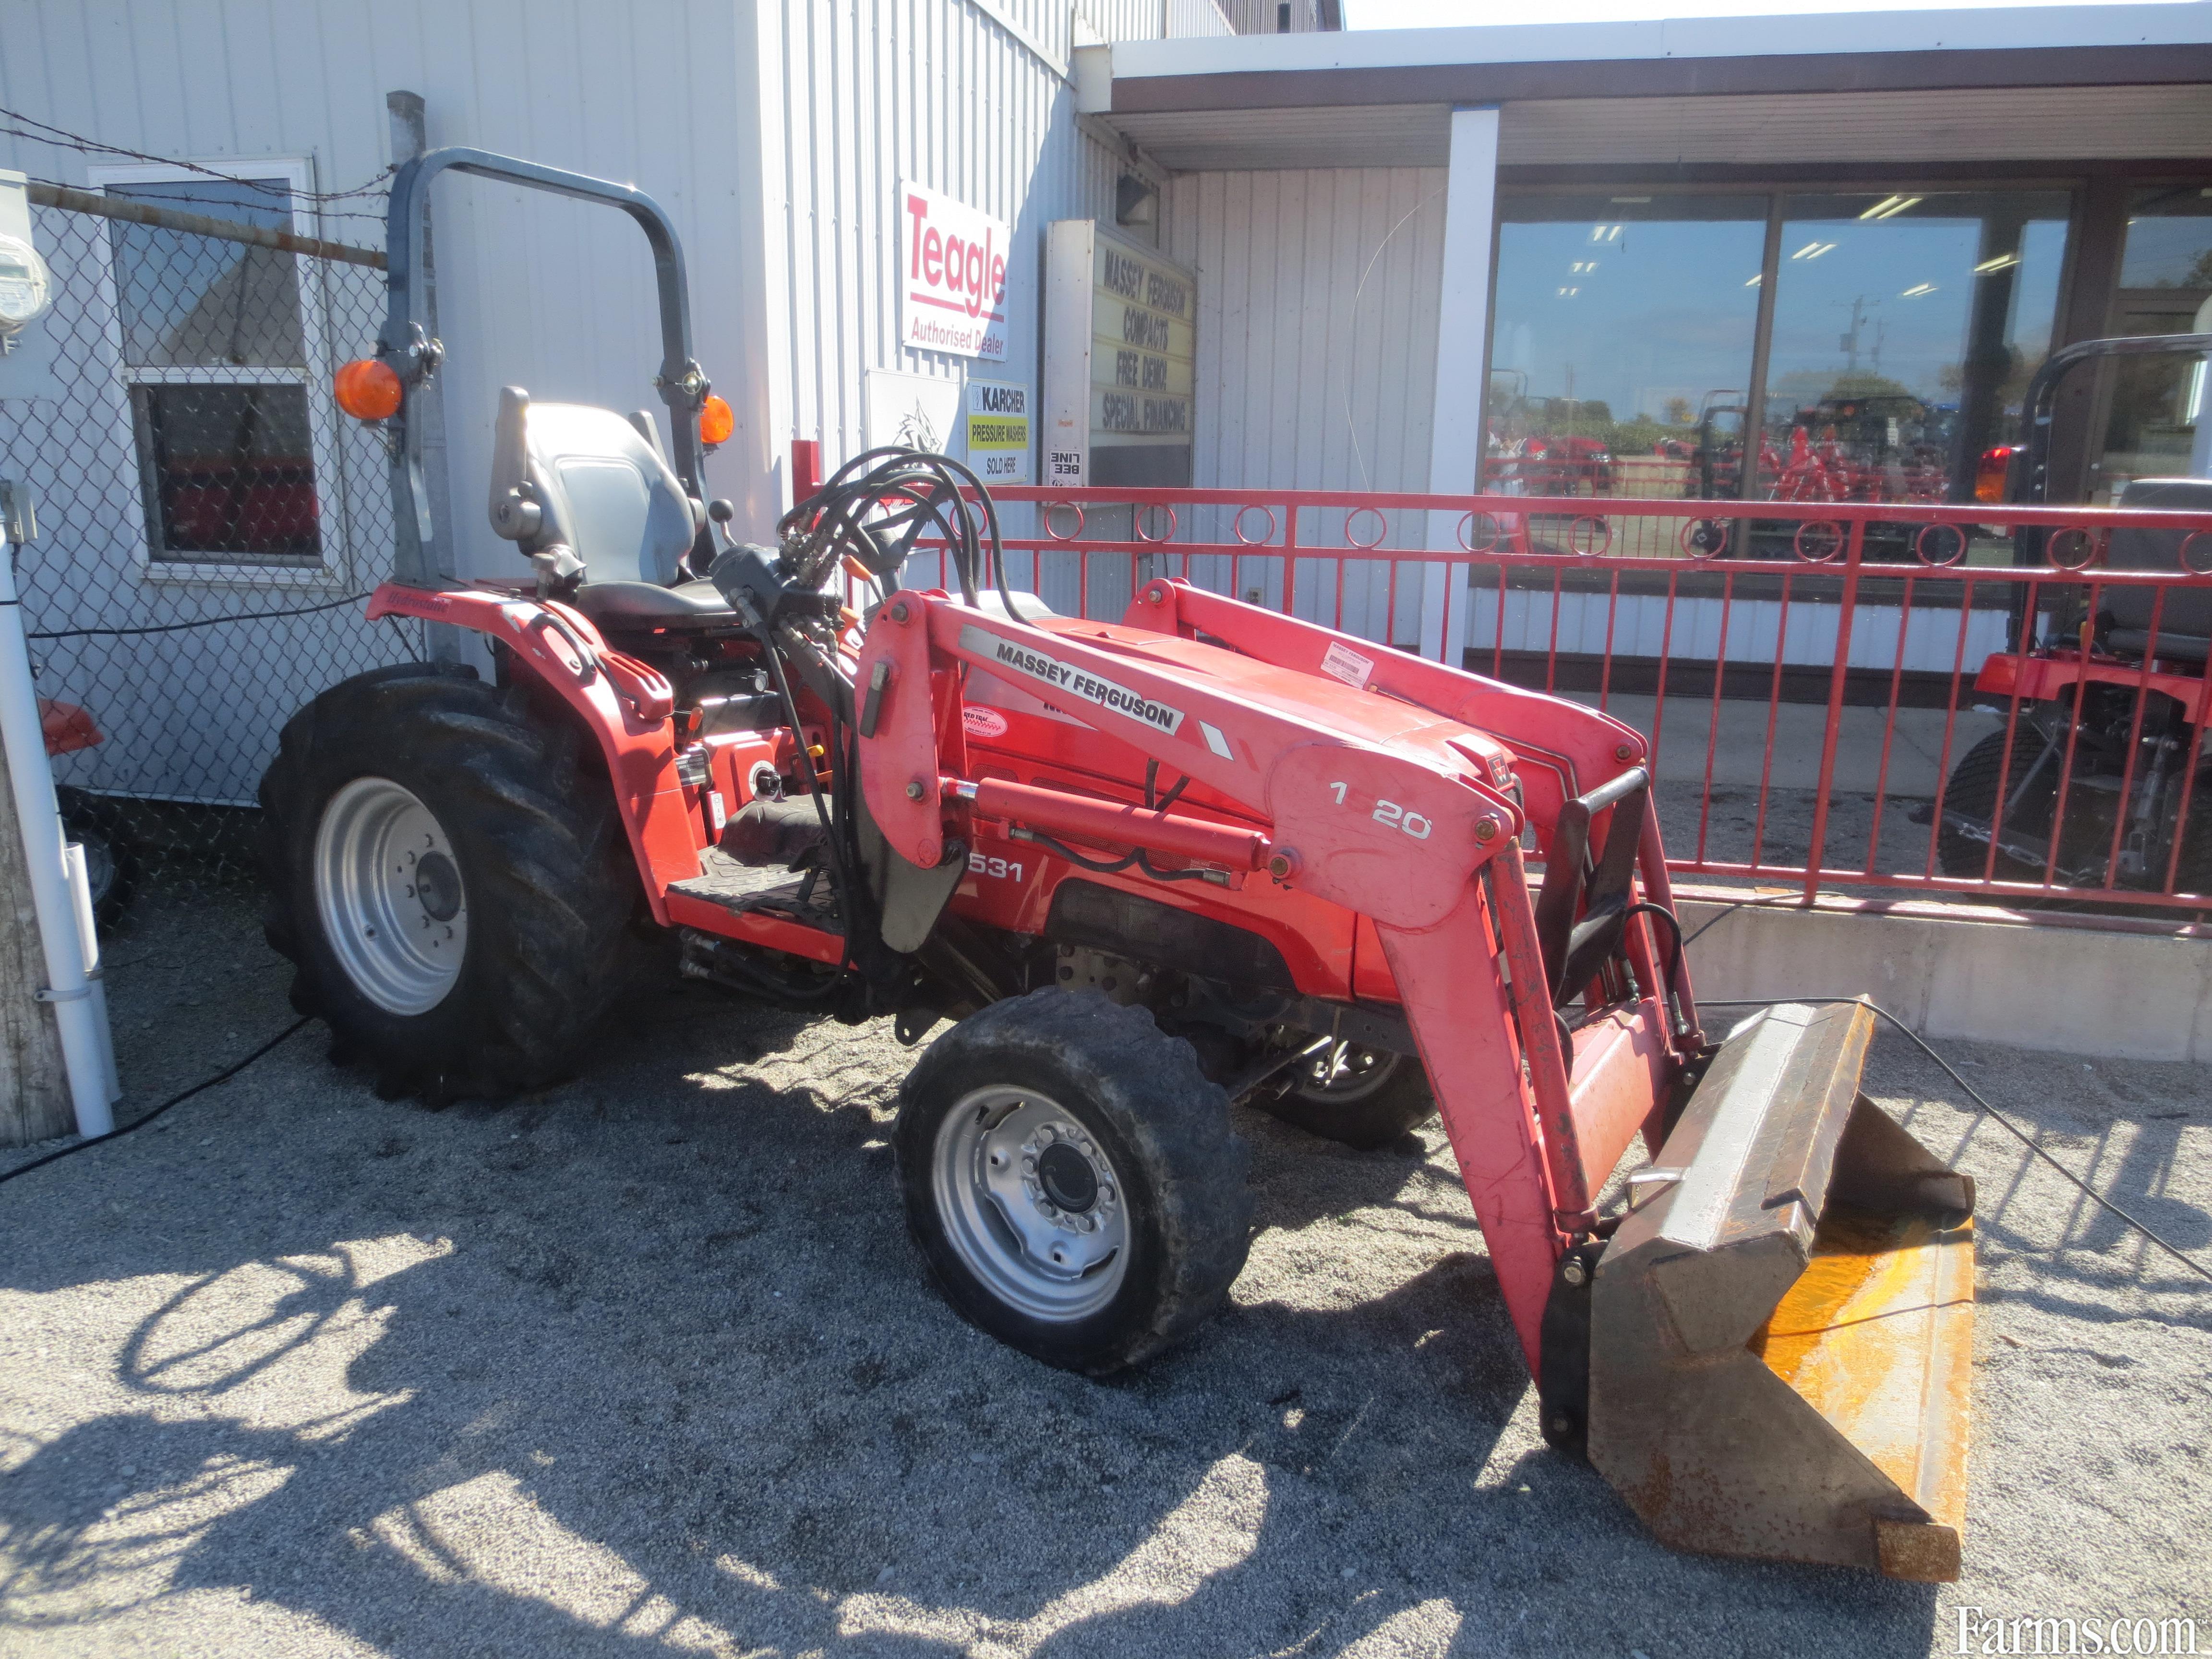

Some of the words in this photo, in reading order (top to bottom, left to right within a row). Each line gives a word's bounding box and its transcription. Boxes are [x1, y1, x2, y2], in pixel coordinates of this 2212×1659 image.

[907, 193, 1006, 319] Teagle
[1104, 249, 1144, 300] MASSEY
[1147, 272, 1186, 316] FERGUSON
[911, 316, 972, 350] Authorised
[975, 329, 1004, 355] Dealer
[1123, 306, 1169, 351] COMPACTS
[1116, 350, 1139, 387] FREE
[982, 386, 1025, 413] KARCHER
[1103, 392, 1140, 430] SPECIAL
[1143, 398, 1186, 430] FINANCING
[972, 424, 1005, 442] PRESSURE
[1006, 425, 1026, 442] WASHERS
[986, 457, 1003, 475] SOLD
[1003, 457, 1016, 474] HERE
[1051, 453, 1080, 463] LINE
[1055, 464, 1080, 474] BEE
[1333, 643, 1348, 653] MASSEY
[1348, 651, 1370, 664] FERGUSON
[997, 642, 1071, 686] MASSEY
[1072, 674, 1175, 729] FERGUSON
